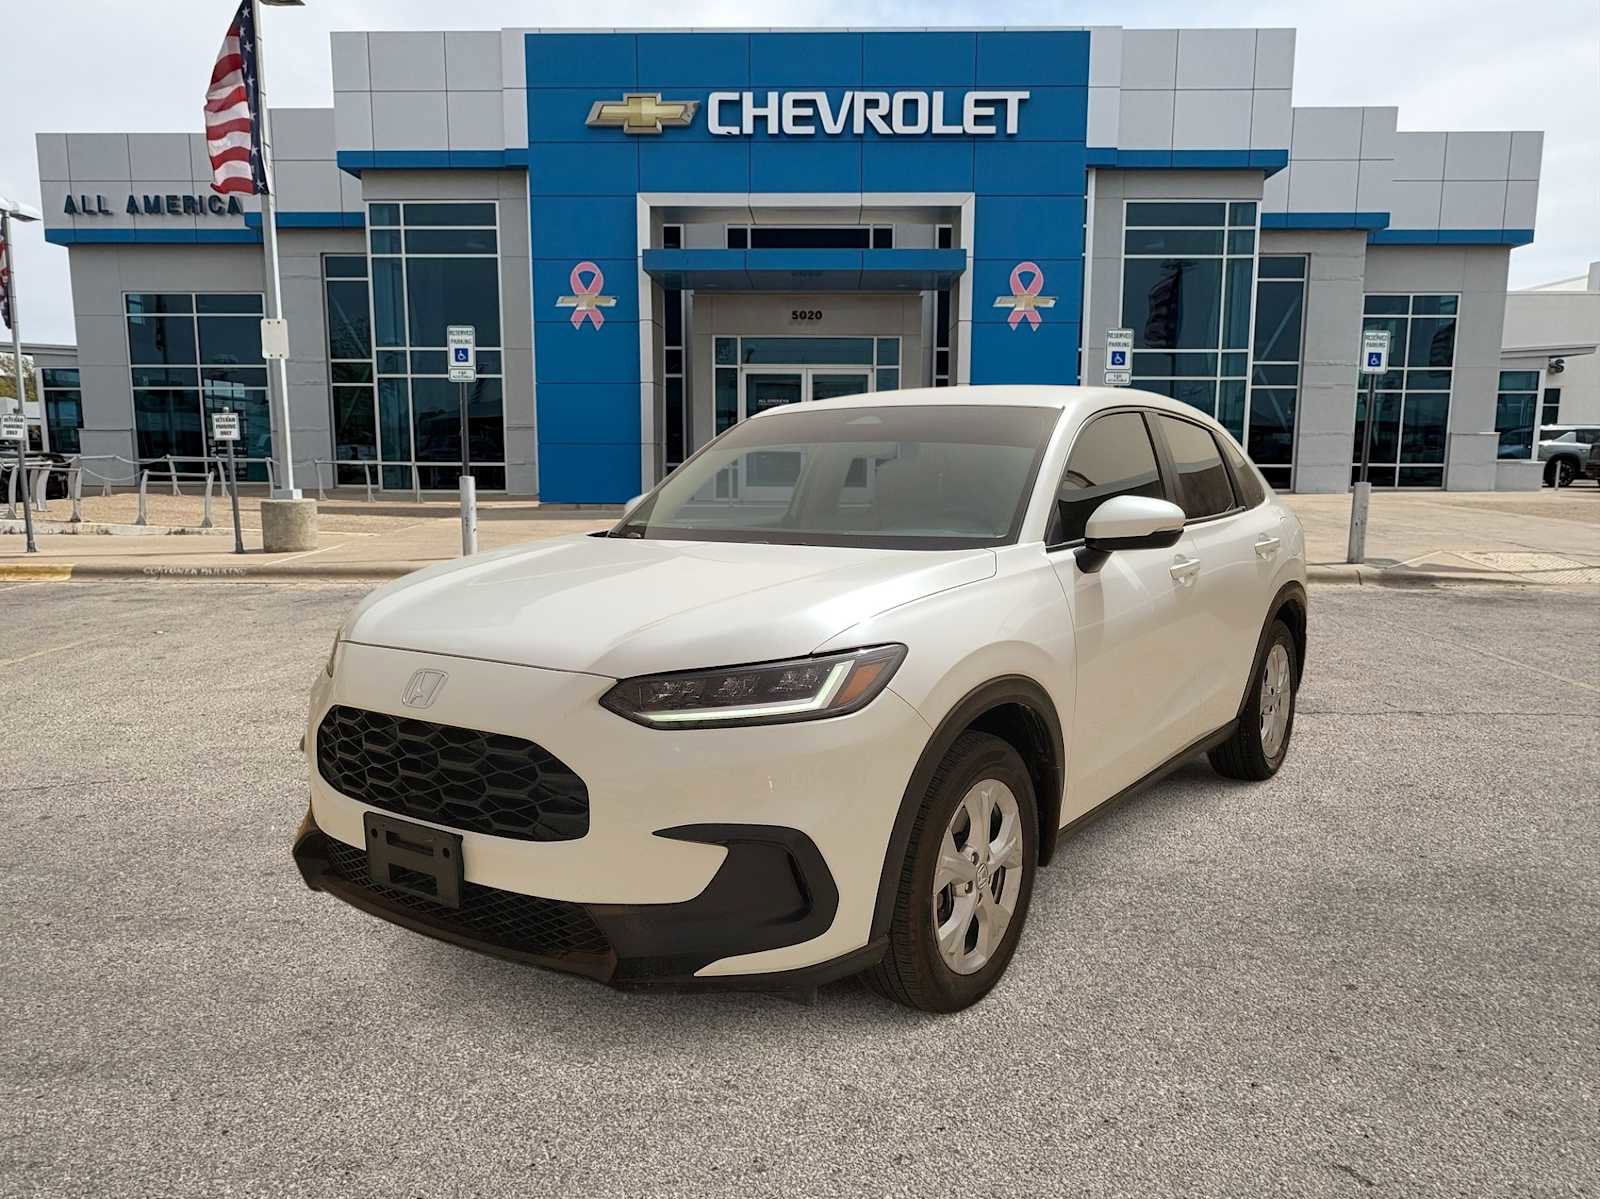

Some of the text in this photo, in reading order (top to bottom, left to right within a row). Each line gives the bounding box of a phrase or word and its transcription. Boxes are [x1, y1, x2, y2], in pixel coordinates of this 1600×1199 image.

[707, 90, 1031, 136] CHEVROLET
[64, 194, 113, 216] ALL
[791, 309, 823, 320] 5020
